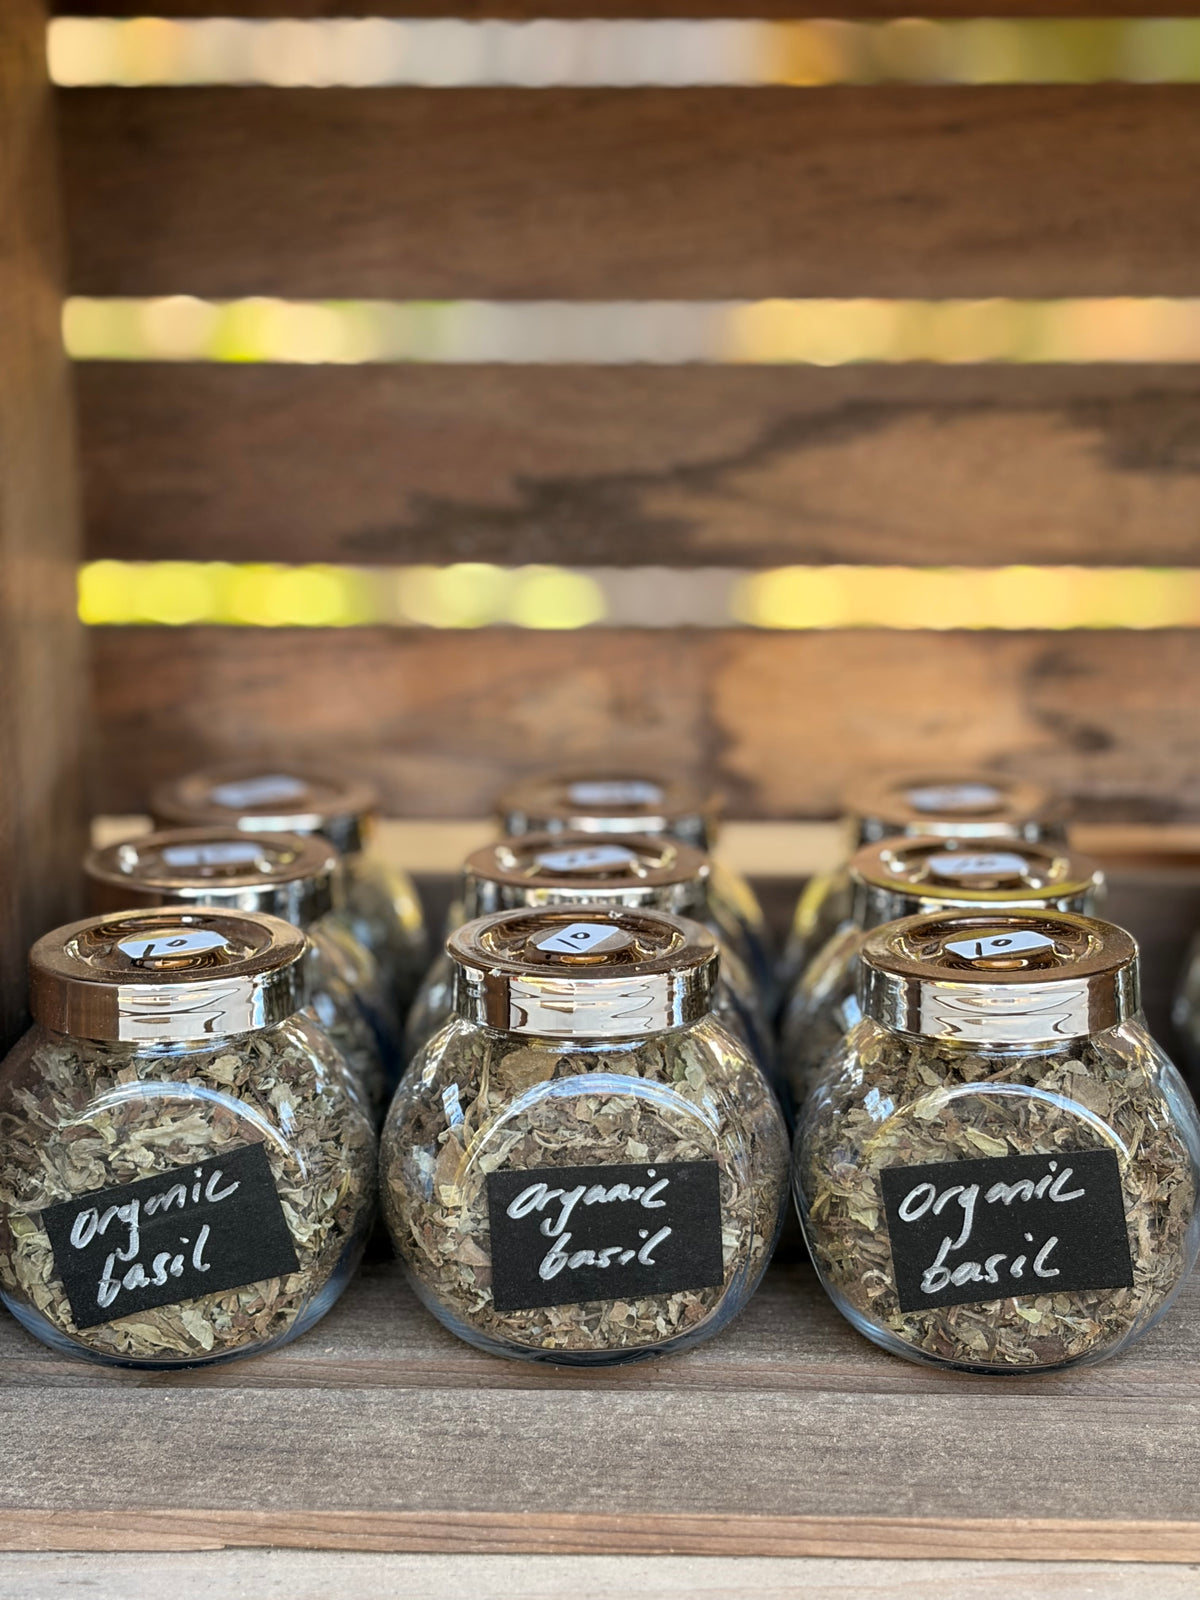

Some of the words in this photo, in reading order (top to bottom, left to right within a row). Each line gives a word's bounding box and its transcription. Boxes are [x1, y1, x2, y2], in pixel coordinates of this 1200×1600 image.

[96, 1223, 211, 1309] basil
[538, 1225, 672, 1281] basil
[920, 1231, 1060, 1294] basil
